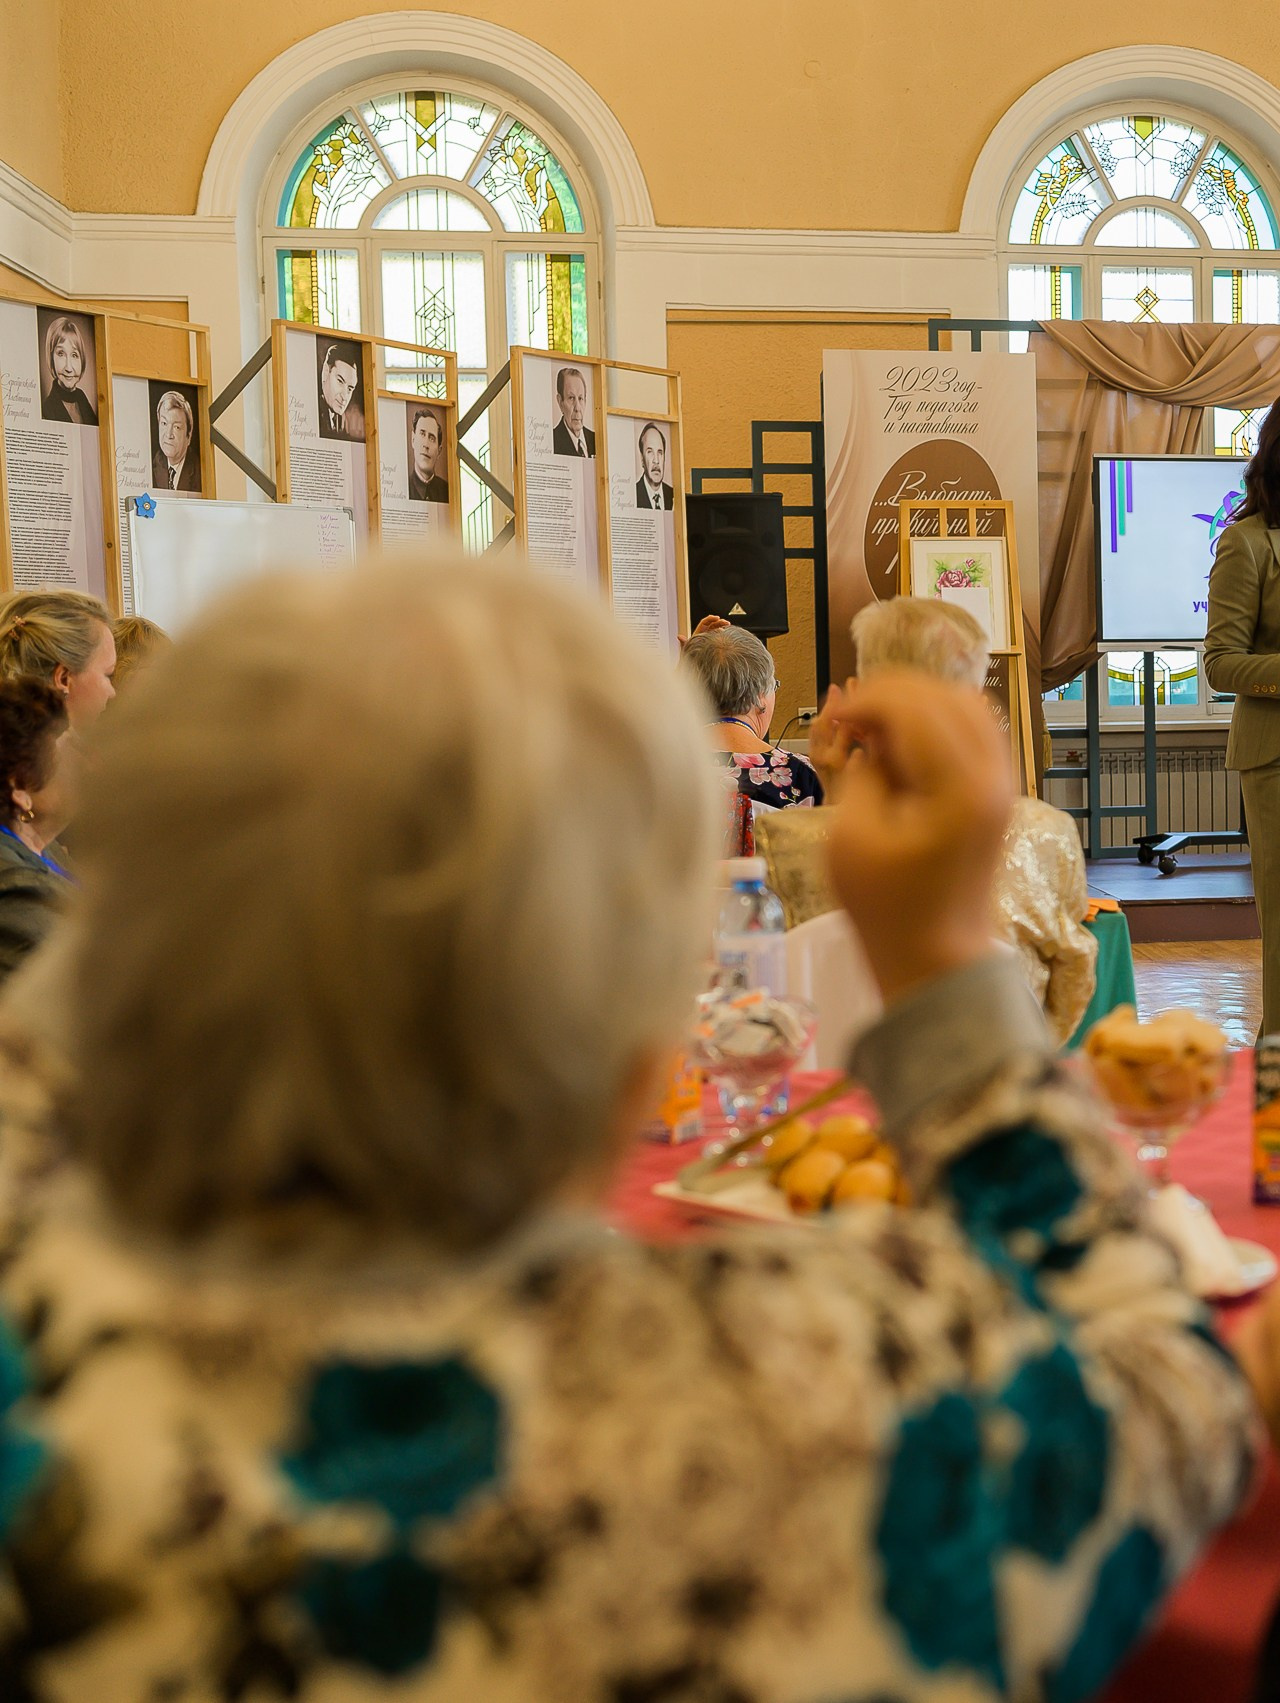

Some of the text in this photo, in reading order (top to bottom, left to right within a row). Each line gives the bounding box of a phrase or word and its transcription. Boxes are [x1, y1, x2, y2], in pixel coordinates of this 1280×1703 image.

[884, 393, 979, 421] Год педагога
[883, 415, 979, 433] и наставника
[1192, 601, 1208, 613] УЧ
